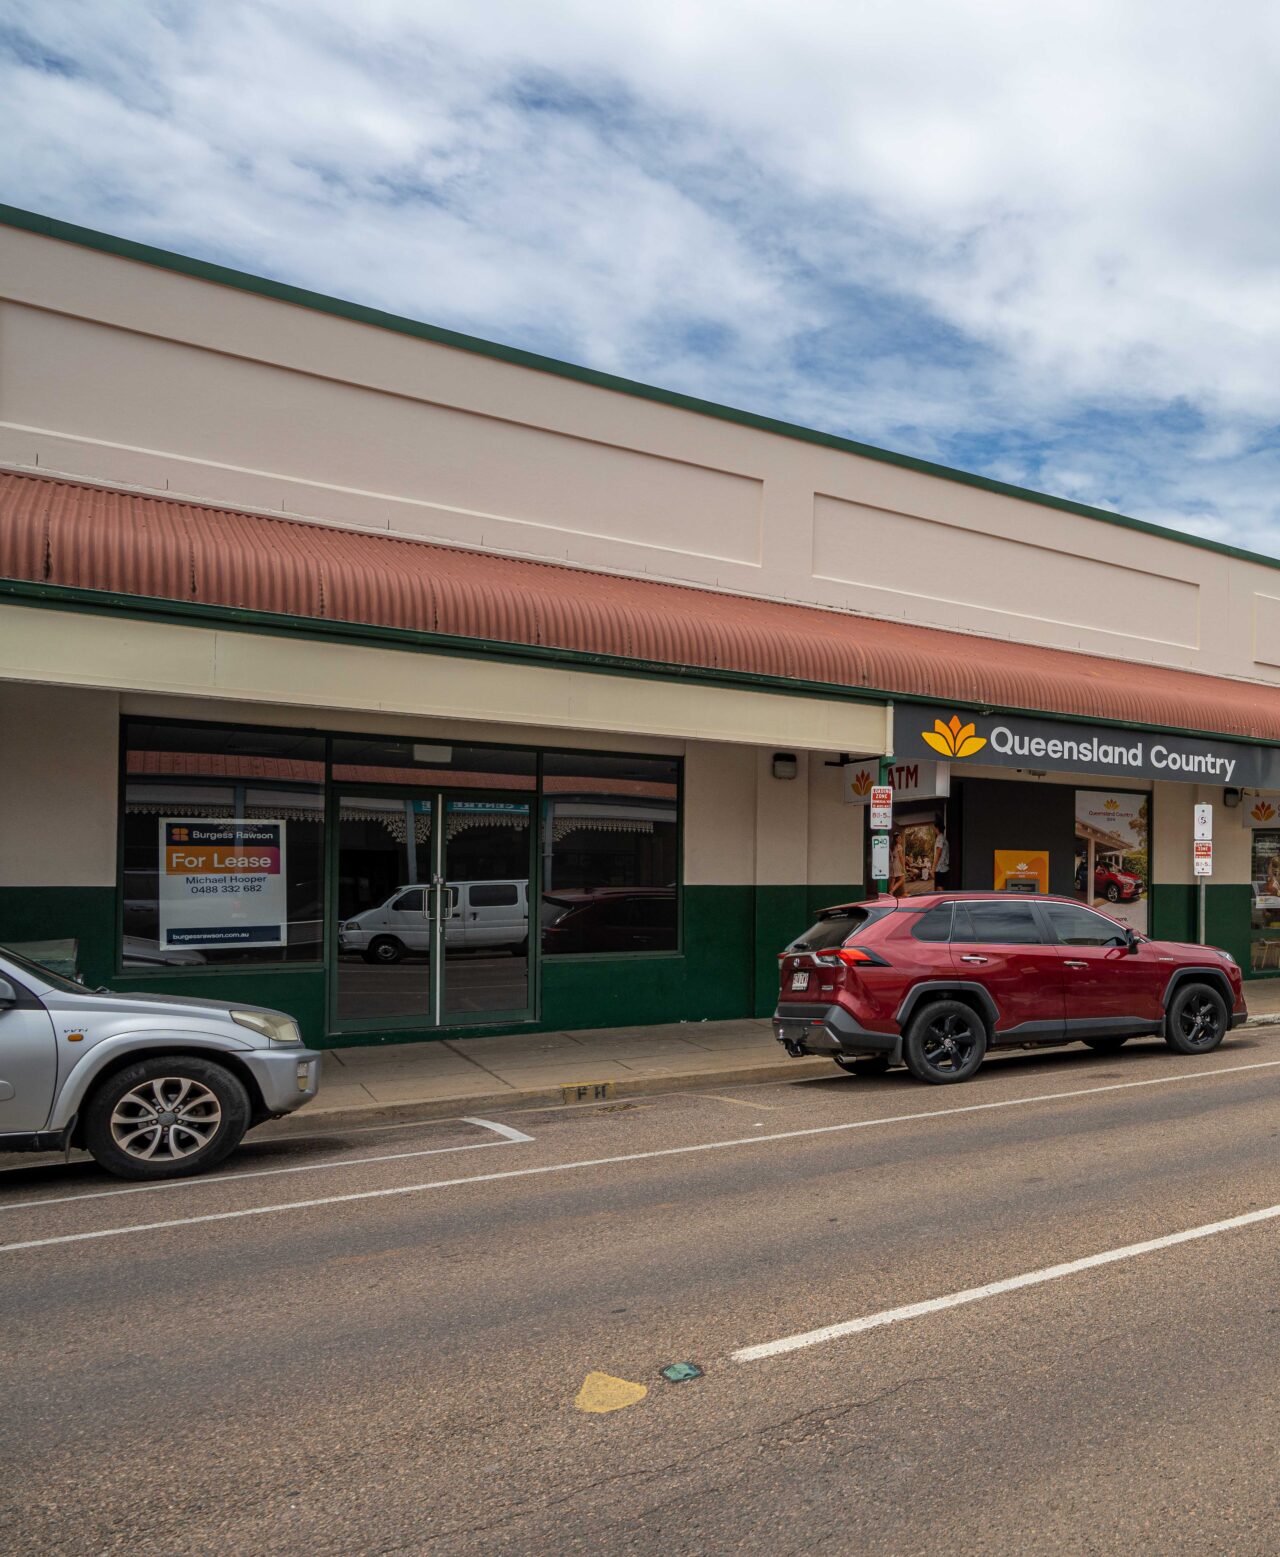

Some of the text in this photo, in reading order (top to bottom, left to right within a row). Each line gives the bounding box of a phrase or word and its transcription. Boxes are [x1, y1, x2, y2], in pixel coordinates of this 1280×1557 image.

[990, 726, 1236, 782] Queensland Country
[887, 764, 919, 790] ATM
[192, 830, 273, 840] Burgess Rawson
[172, 853, 272, 868] For Lease
[185, 876, 267, 884] Michael Hooper
[191, 884, 262, 894] 0488 332 682
[172, 932, 250, 940] burgessrawson.com.au
